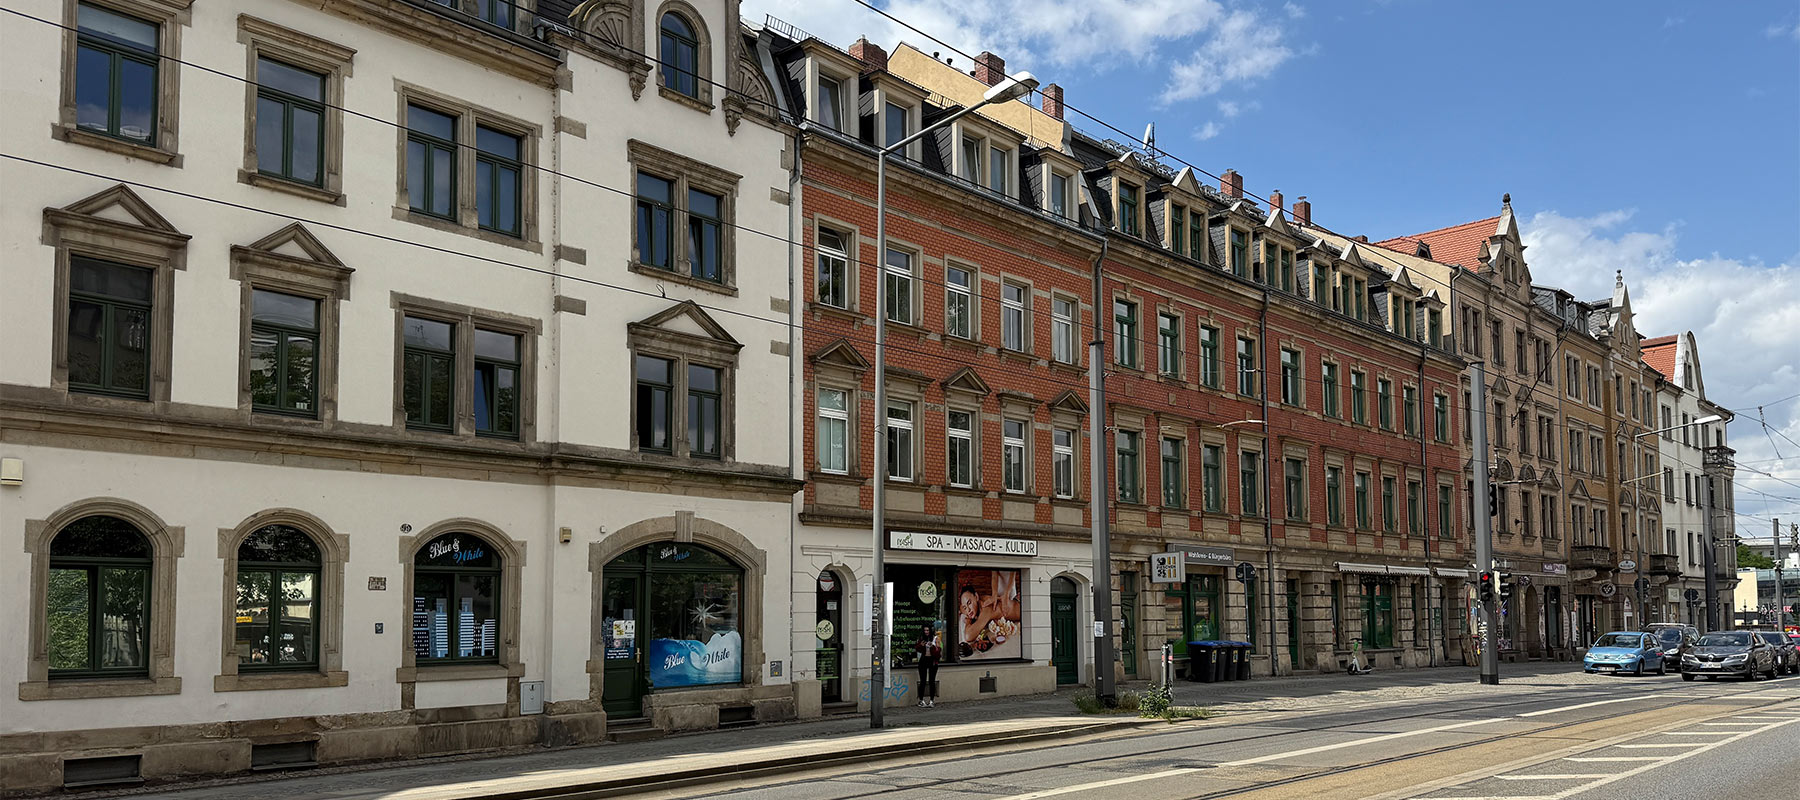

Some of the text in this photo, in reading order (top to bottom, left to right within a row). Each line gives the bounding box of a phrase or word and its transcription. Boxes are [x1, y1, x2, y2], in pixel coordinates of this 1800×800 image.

[429, 538, 460, 559] Blue &
[926, 535, 944, 549] SPA
[953, 537, 997, 552] MASSAGE
[1005, 540, 1035, 554] KULTUR
[453, 548, 484, 563] White
[663, 648, 730, 670] Blue White
